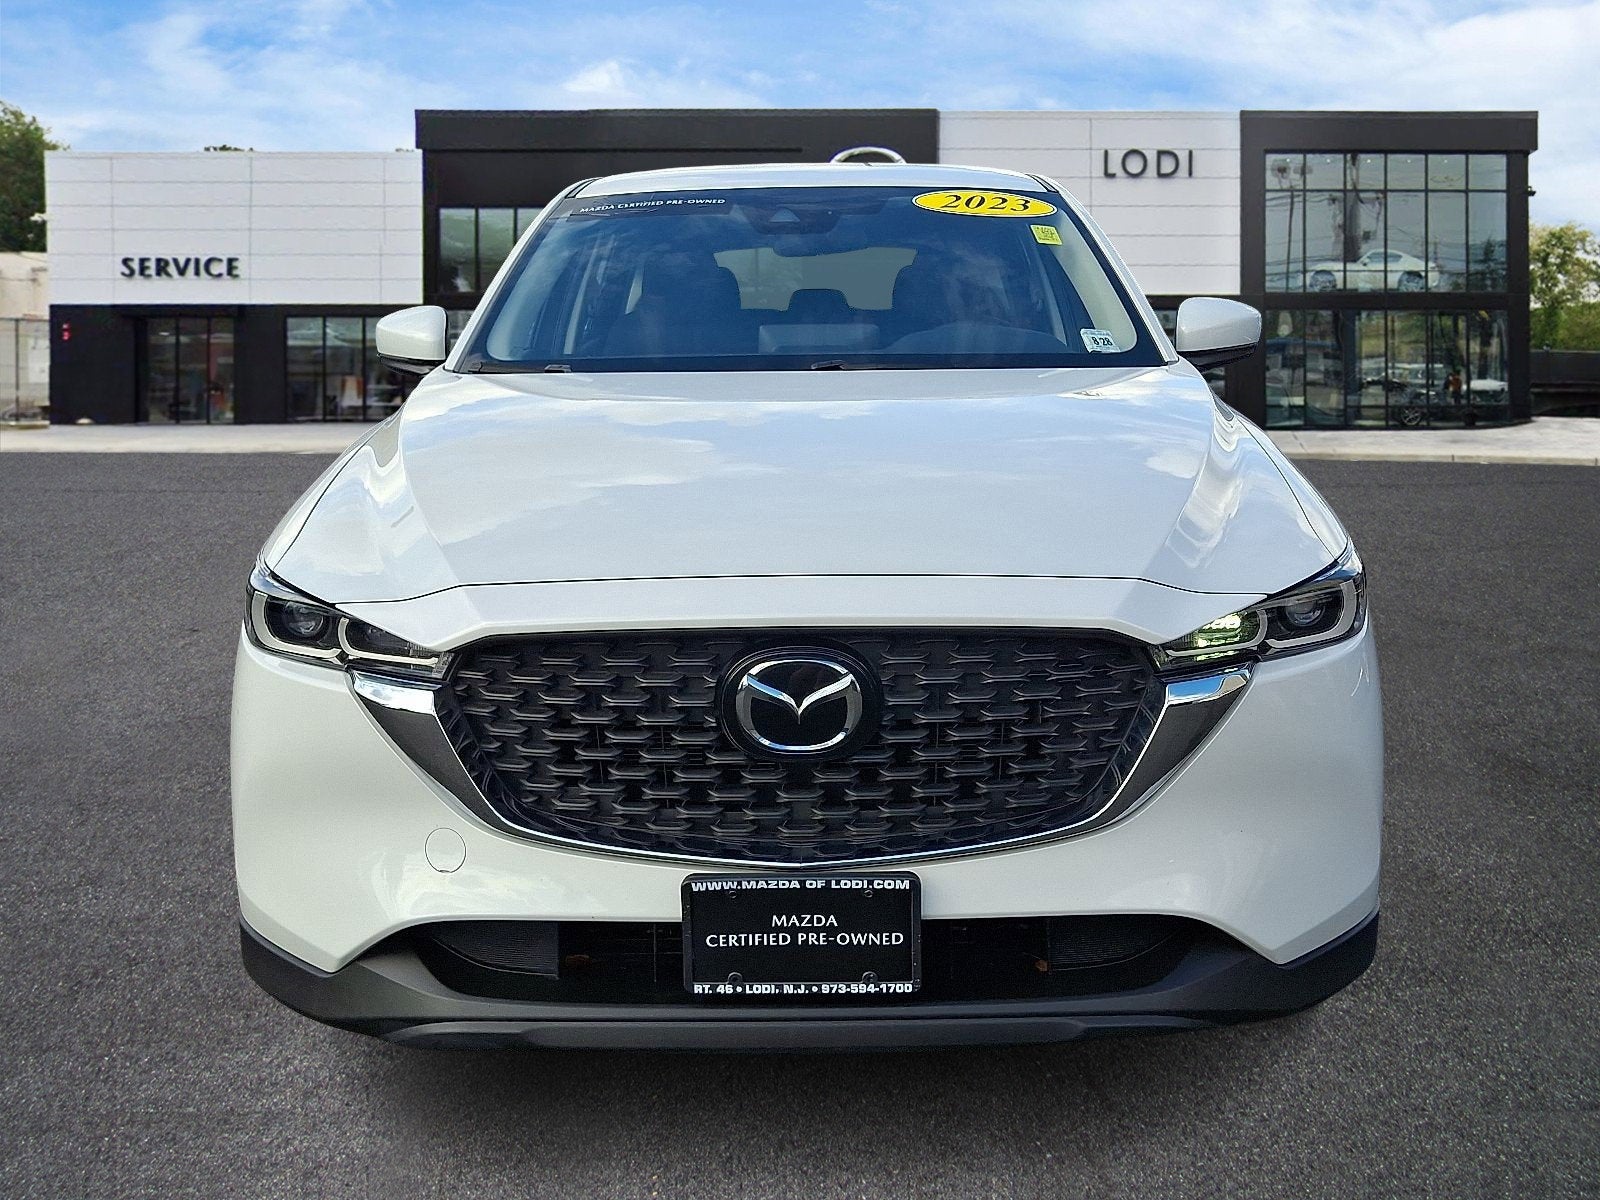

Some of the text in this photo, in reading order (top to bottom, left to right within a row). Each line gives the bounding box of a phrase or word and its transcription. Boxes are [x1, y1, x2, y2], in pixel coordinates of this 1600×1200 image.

[1104, 149, 1193, 178] LODI
[580, 204, 615, 213] MAZDA
[617, 200, 664, 209] CERTIFIED
[940, 195, 1031, 212] 2023
[120, 257, 240, 278] SERVICE
[691, 880, 910, 892] WWW.MAZDA OF LODI.COM
[771, 914, 838, 927] MAZDA
[705, 932, 904, 947] CERTIFIED PRE-OWNED
[693, 983, 913, 994] RT. 46 LODI, N.J. 973-594-1700
